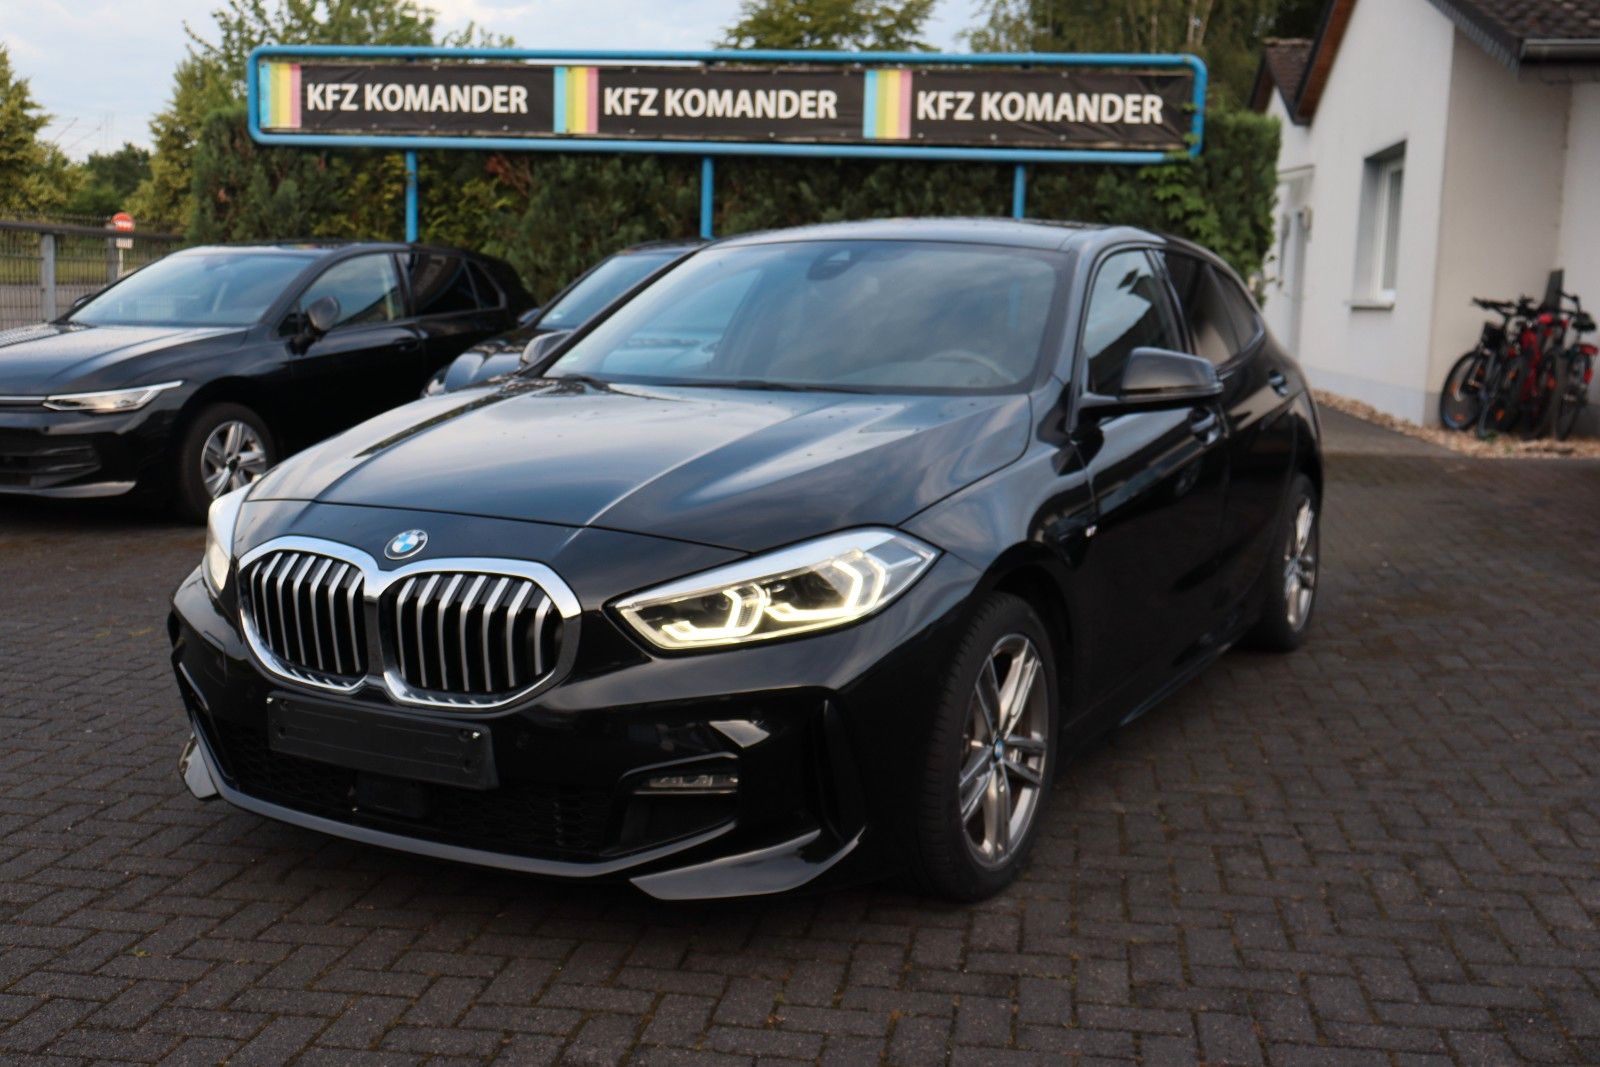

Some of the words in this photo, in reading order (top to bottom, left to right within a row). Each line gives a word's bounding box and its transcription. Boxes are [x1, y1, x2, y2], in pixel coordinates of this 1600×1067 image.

[307, 84, 359, 111] KFZ
[365, 84, 528, 113] KOMANDER
[605, 87, 658, 116] KFZ
[665, 88, 837, 119] KOMANDER
[917, 91, 975, 120] KFZ
[981, 92, 1163, 124] KOMANDER
